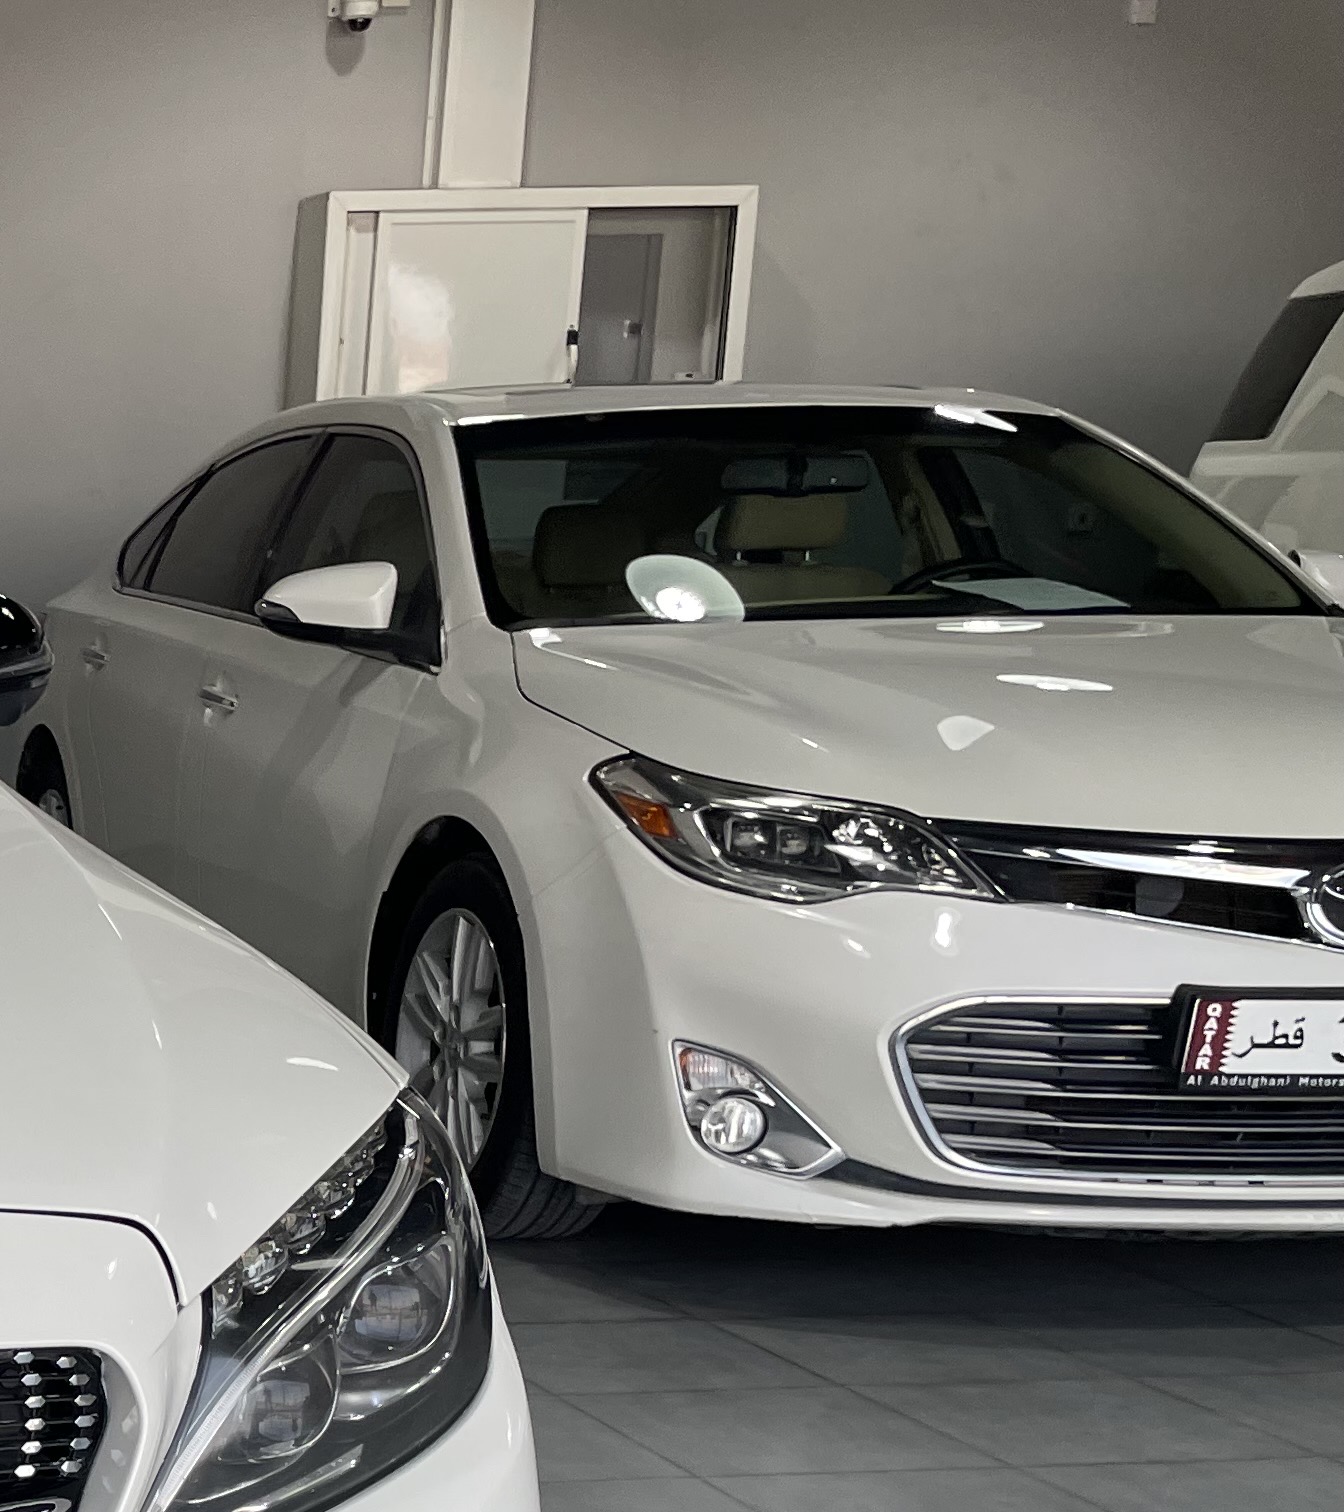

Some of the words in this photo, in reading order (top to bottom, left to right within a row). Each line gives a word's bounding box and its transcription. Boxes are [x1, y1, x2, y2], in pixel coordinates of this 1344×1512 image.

[1194, 1002, 1223, 1070] QATAR
[1231, 1016, 1306, 1058] قطر
[1186, 1074, 1202, 1086] Al
[1210, 1074, 1291, 1089] Abdulghani
